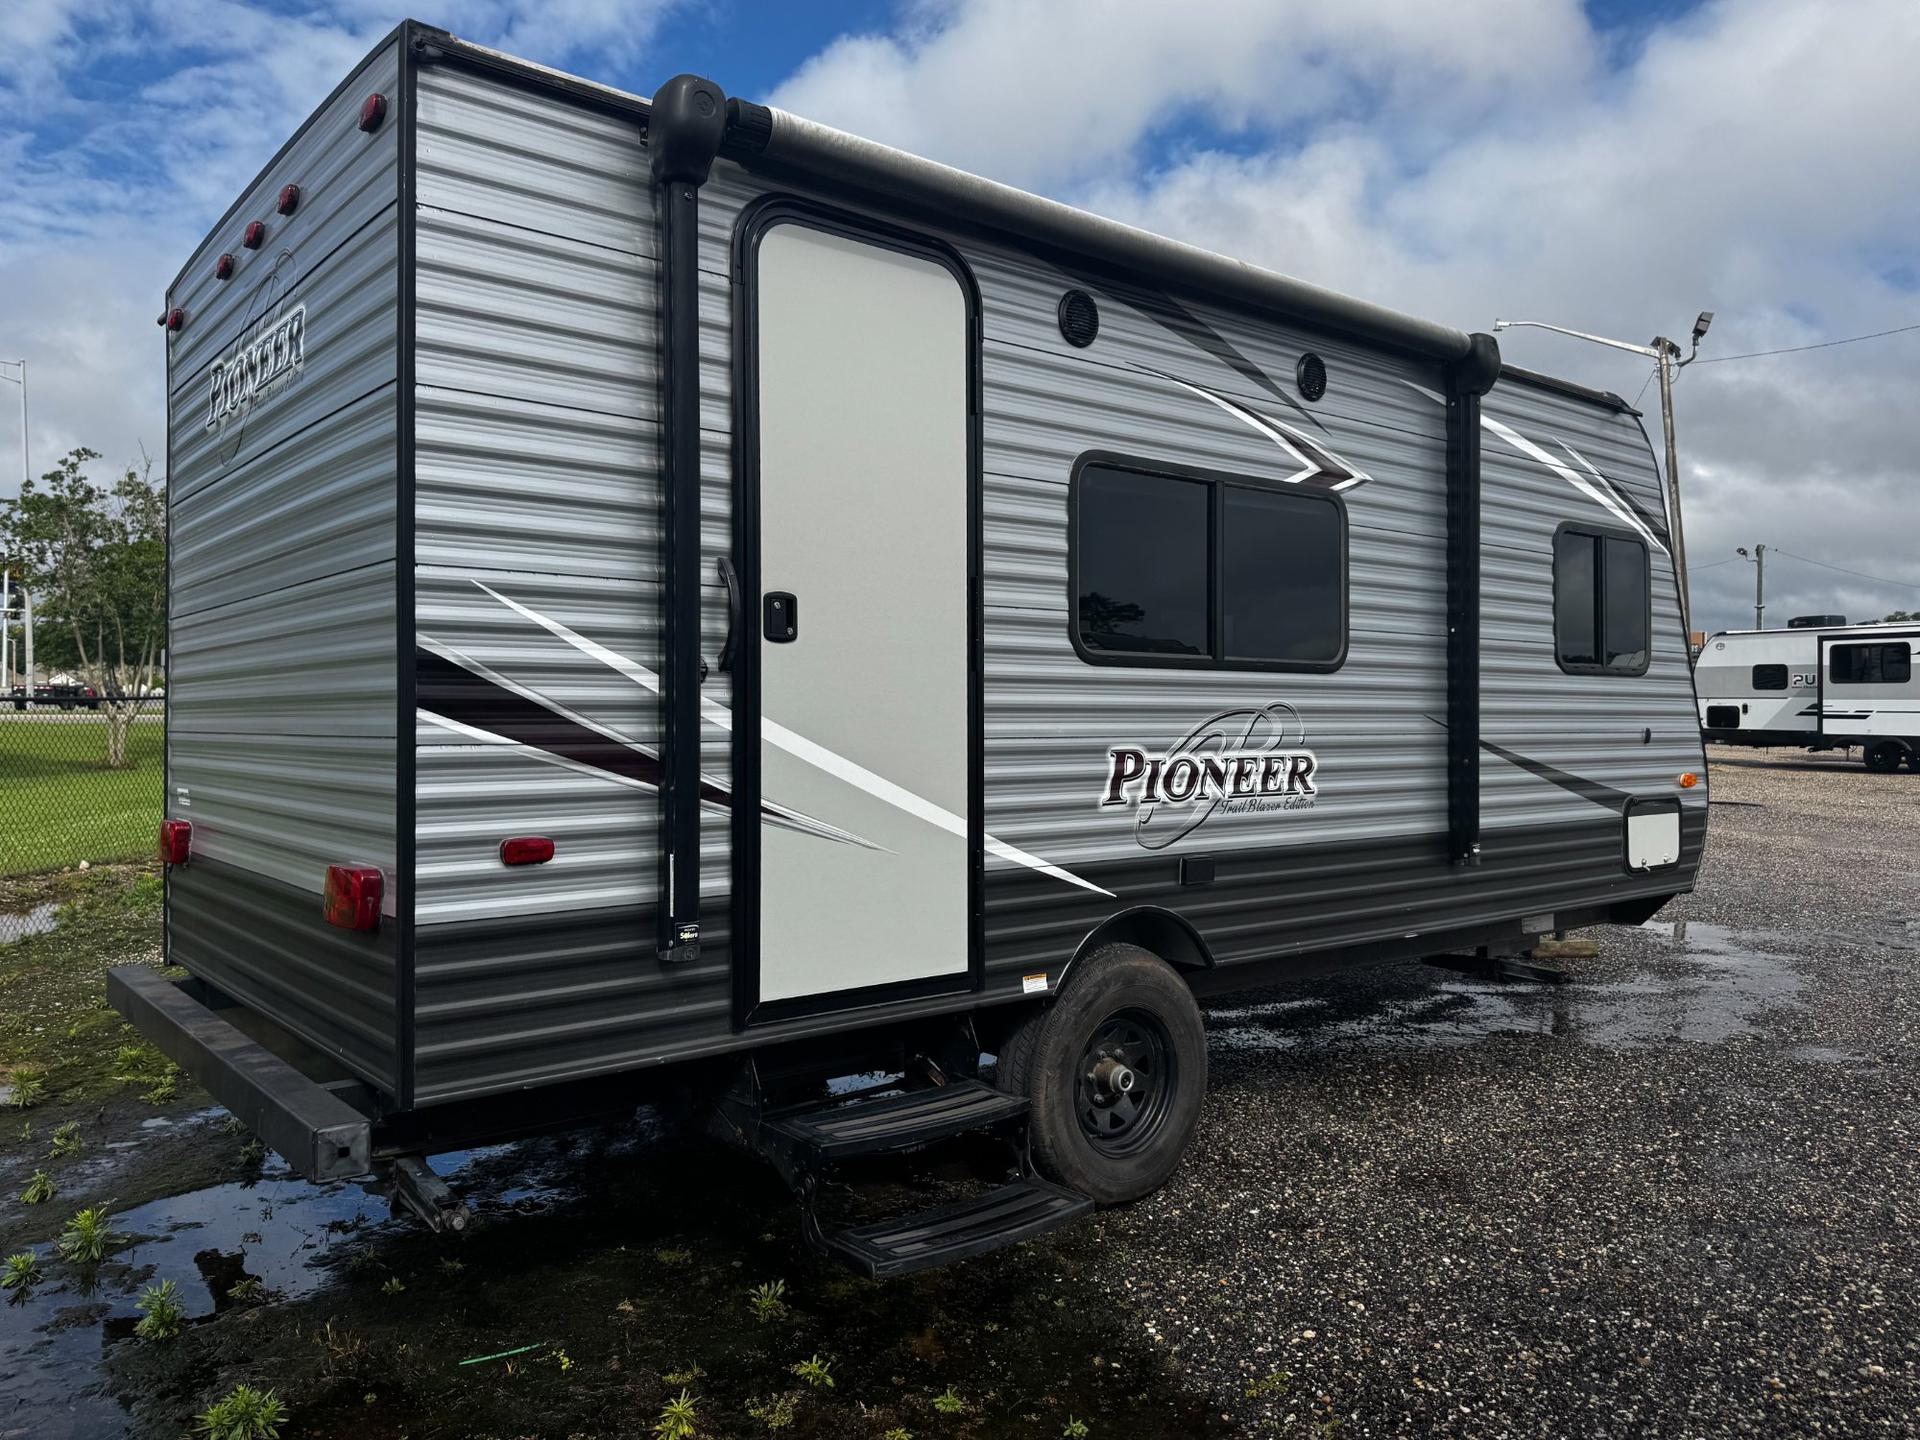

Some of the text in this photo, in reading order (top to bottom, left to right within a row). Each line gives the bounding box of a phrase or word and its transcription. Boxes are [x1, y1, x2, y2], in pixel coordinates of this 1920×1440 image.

[206, 306, 304, 428] PIONEER
[1101, 747, 1316, 807] PIONEER
[1220, 796, 1315, 815] Trail Blazer Edition
